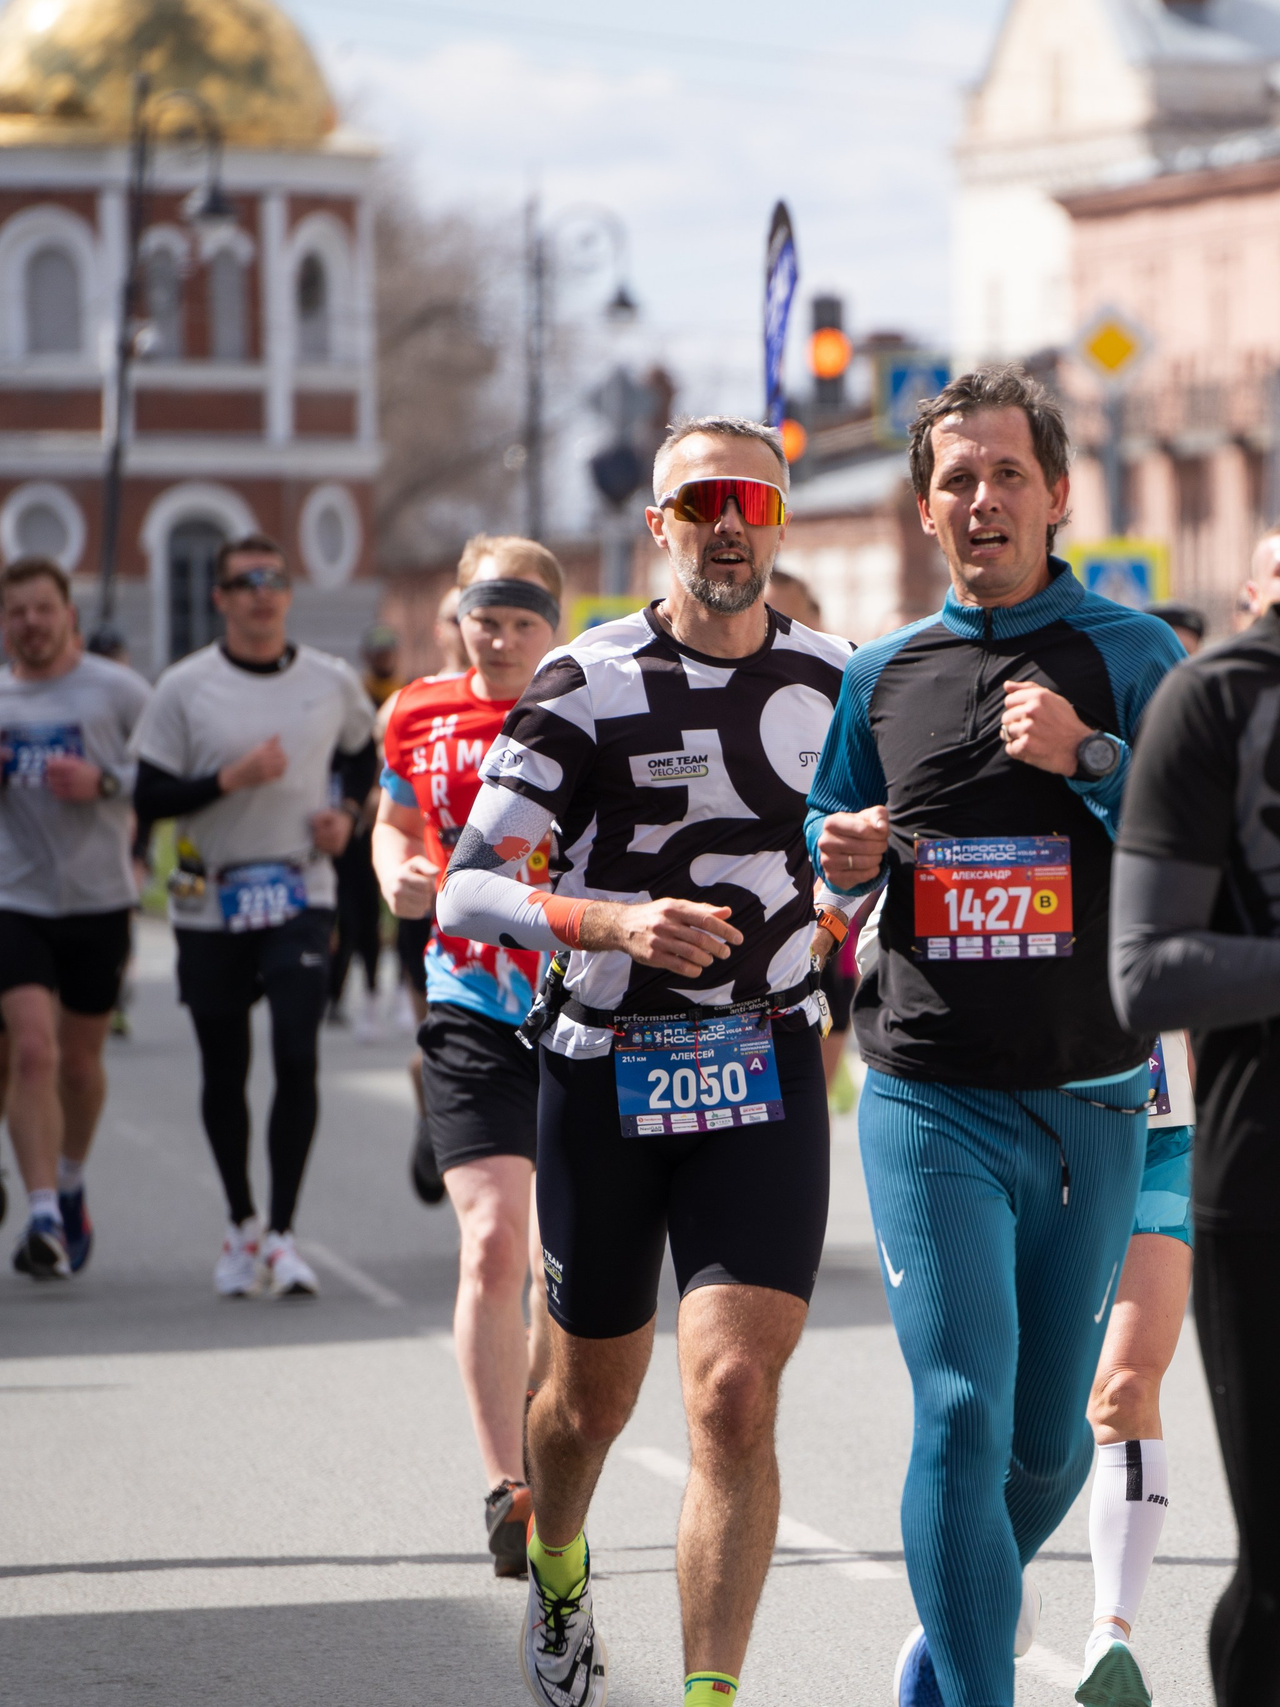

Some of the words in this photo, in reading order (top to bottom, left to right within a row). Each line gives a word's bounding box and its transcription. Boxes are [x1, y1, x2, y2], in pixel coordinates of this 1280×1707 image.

[647, 757, 674, 768] ONE
[676, 754, 708, 765] TEAM
[650, 765, 701, 777] VELOSPORT
[962, 844, 1017, 852] ПРОСТО
[952, 852, 1017, 861] КОСМОС
[951, 870, 1012, 881] АЛЕКСАНДР
[1039, 895, 1052, 908] B
[944, 886, 1032, 931] 1427
[730, 1000, 770, 1015] anti-shock
[613, 1013, 687, 1024] performance
[664, 1031, 726, 1044] КОСМОС
[670, 1049, 715, 1061] АЛЕКСЕЙ
[750, 1057, 763, 1071] A
[1148, 1057, 1159, 1070] A
[647, 1061, 748, 1109] 2050
